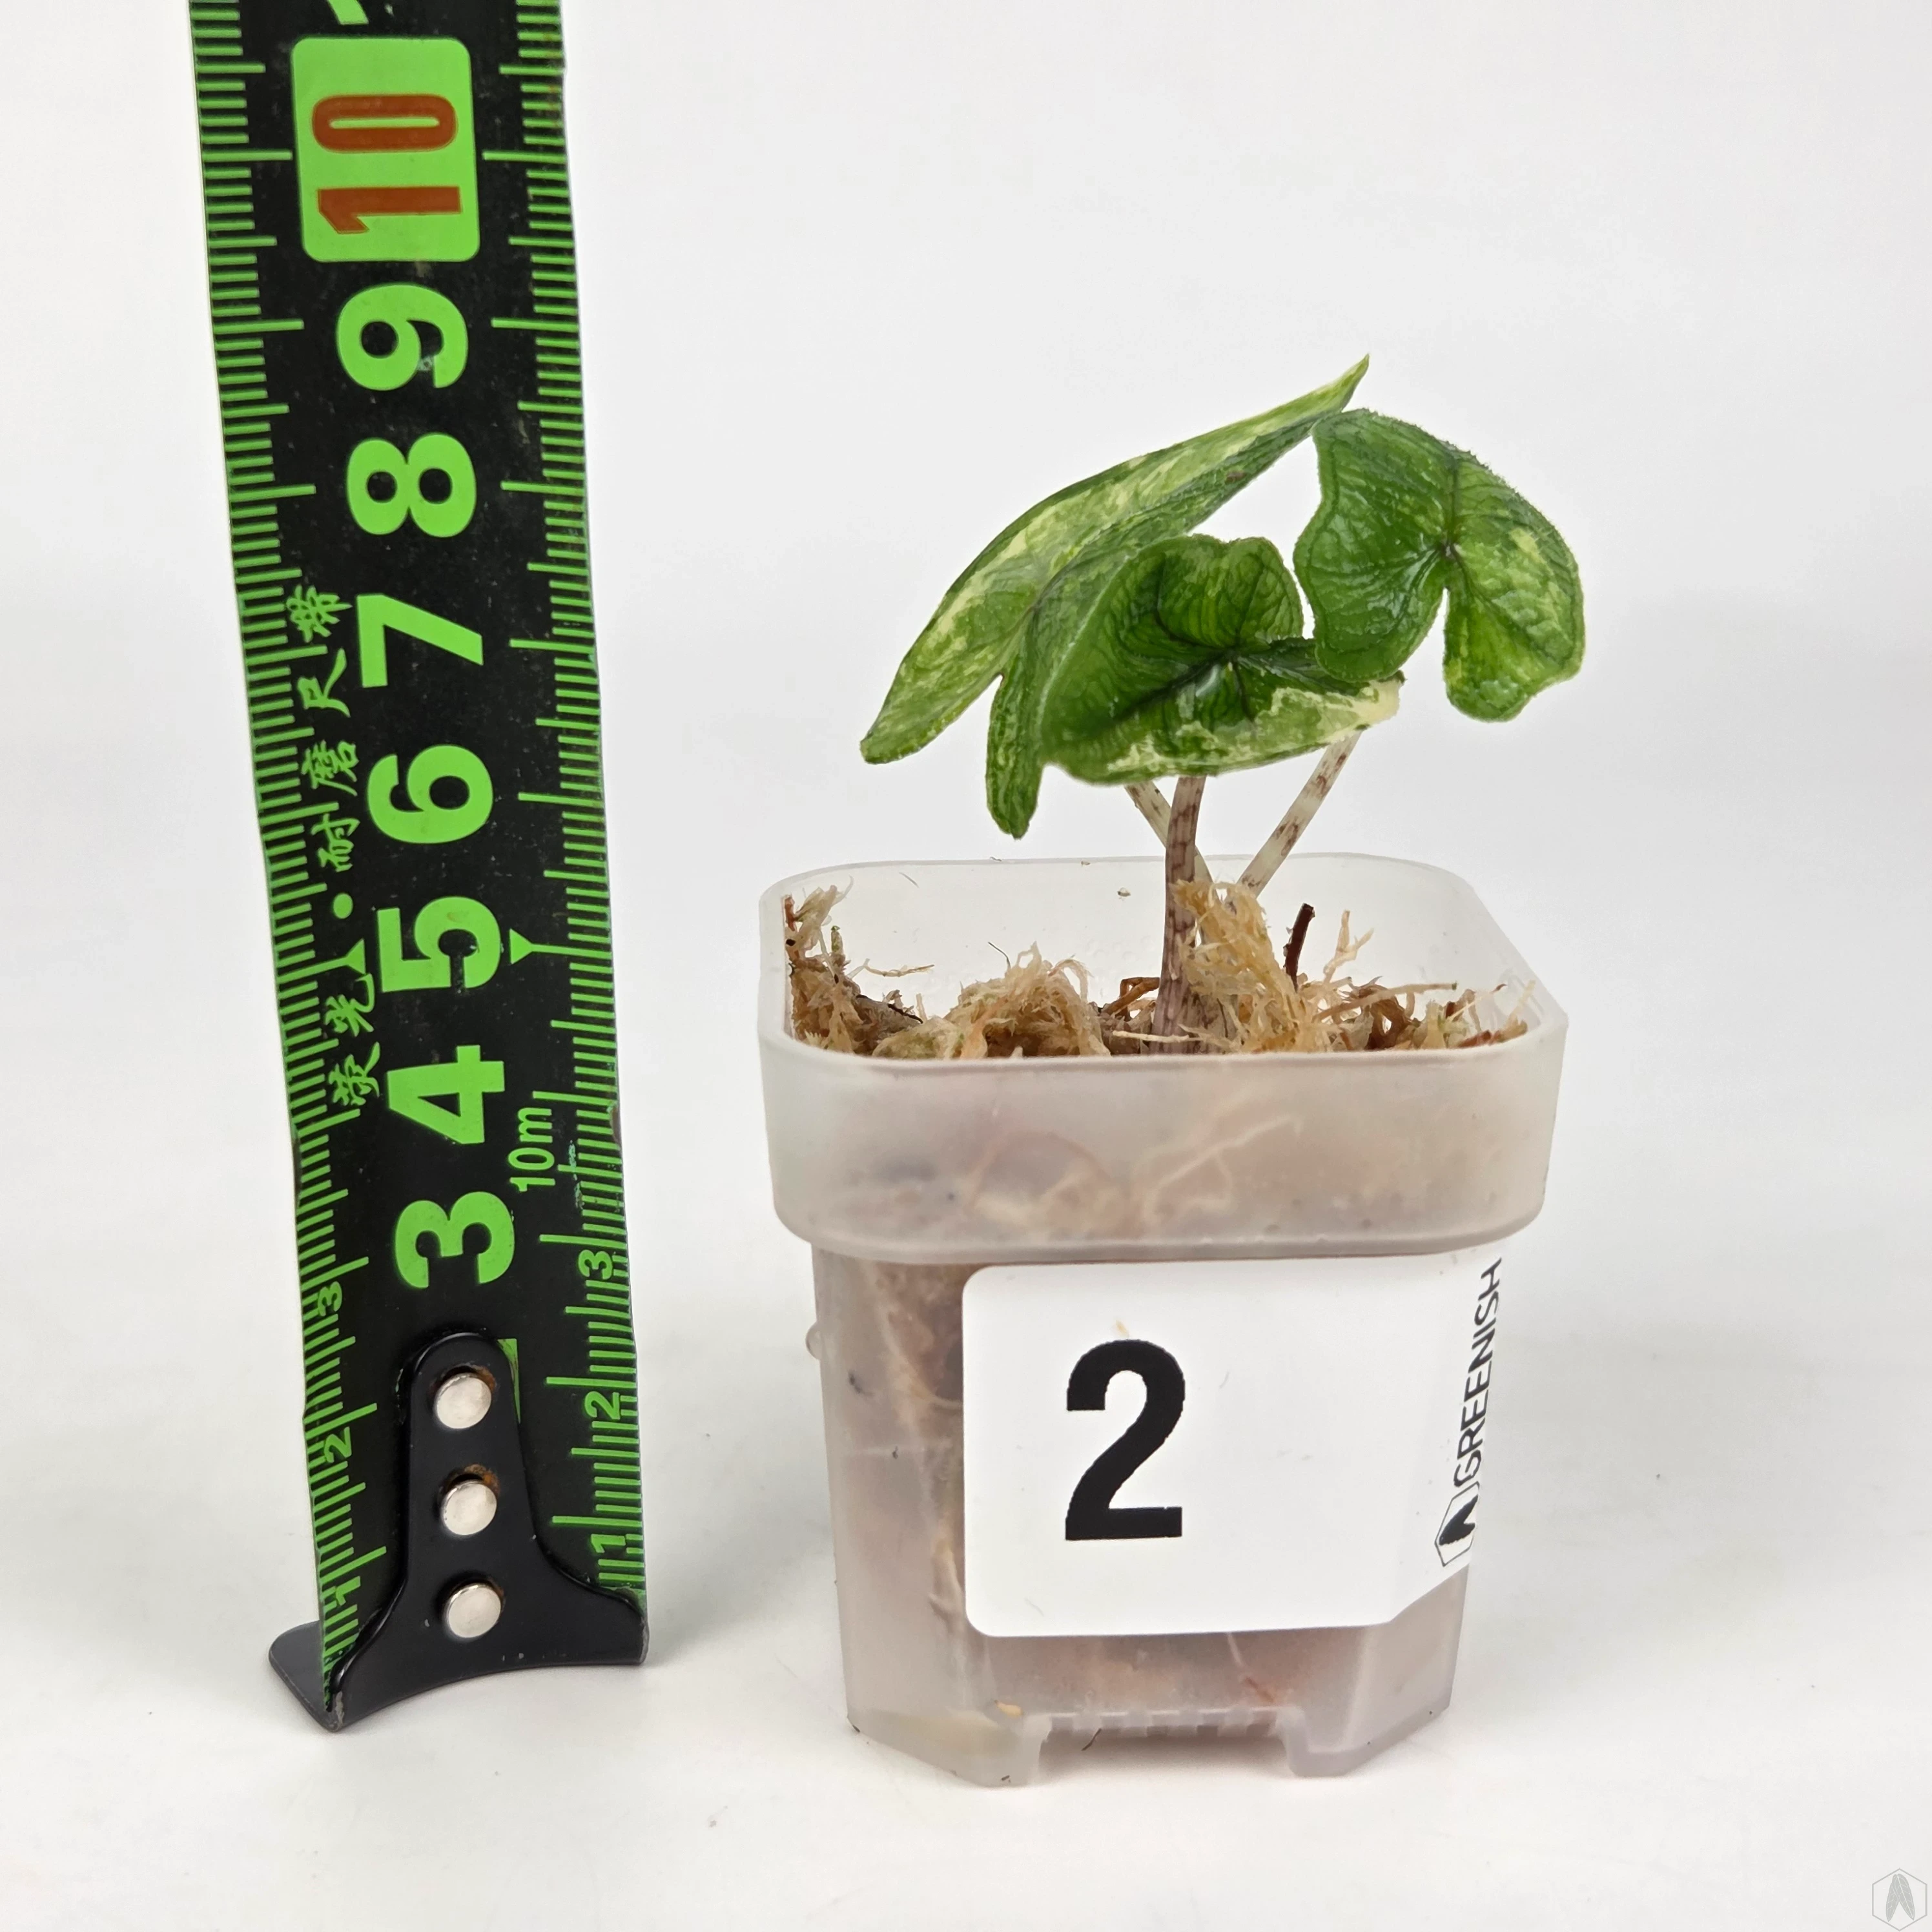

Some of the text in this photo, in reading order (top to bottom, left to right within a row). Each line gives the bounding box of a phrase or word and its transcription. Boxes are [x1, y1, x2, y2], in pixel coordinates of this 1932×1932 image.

[313, 94, 462, 234] 10
[336, 283, 469, 391] 9
[346, 432, 477, 538] 8
[356, 594, 484, 688] 7
[366, 744, 494, 845] 6
[376, 896, 502, 992] 5
[386, 1044, 505, 1145] 4
[508, 1106, 556, 1193] 10m
[394, 1191, 515, 1290] 3
[577, 1249, 613, 1280] 3
[318, 1280, 343, 1317] 3
[584, 1390, 621, 1421] 2
[1453, 1257, 1503, 1488] GREENISH
[324, 1426, 353, 1464] 2
[1065, 1340, 1186, 1541] 2
[590, 1533, 627, 1554] 1
